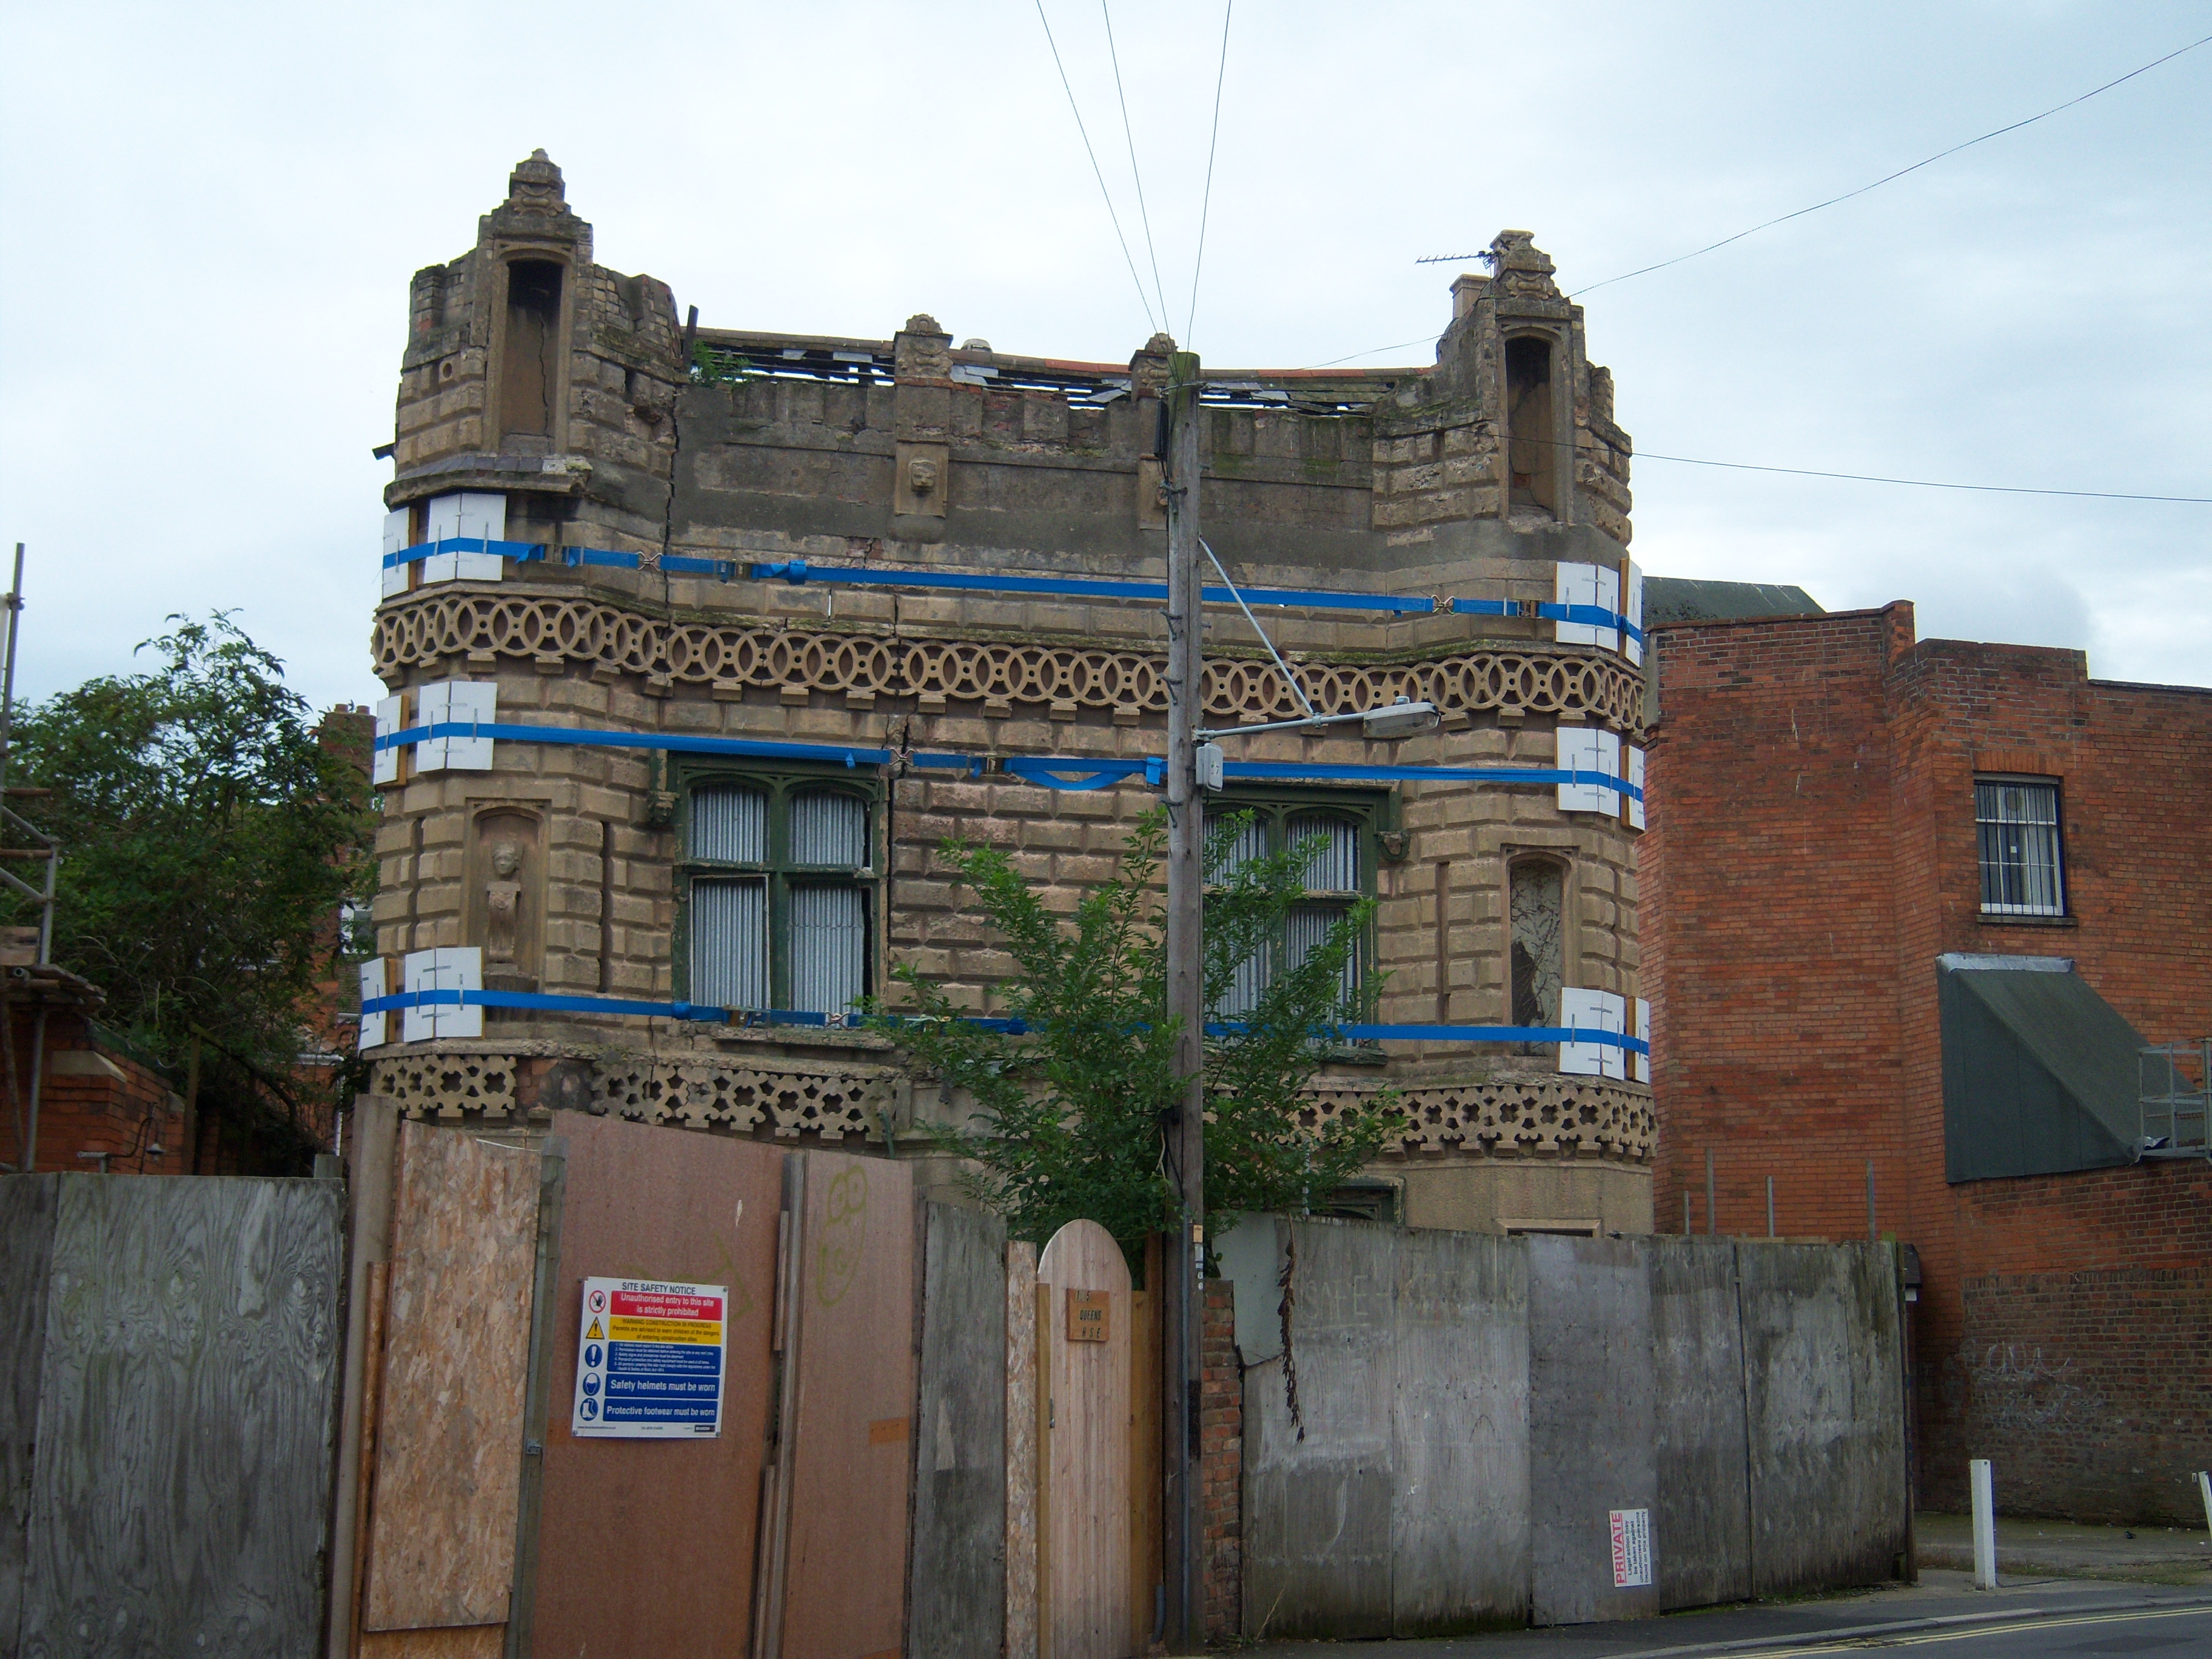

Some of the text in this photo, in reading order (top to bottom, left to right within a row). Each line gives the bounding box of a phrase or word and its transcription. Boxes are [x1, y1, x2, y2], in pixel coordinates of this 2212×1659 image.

[622, 1282, 696, 1295] SITE SAFETY NOTICE
[621, 1293, 664, 1304] Unauthorised
[666, 1296, 681, 1306] entry
[690, 1298, 702, 1306] this
[637, 1305, 699, 1316] is strictly prohibited
[1080, 1309, 1101, 1321] QUEENS
[611, 1379, 635, 1392] Safety
[637, 1380, 666, 1391] helmets
[668, 1382, 686, 1391] must
[688, 1381, 697, 1391] be
[607, 1406, 643, 1415] Protective
[644, 1406, 672, 1415] footwear
[691, 1407, 699, 1415] be
[1610, 1512, 1625, 1584] PRIVATE
[1634, 1566, 1638, 1575] be
